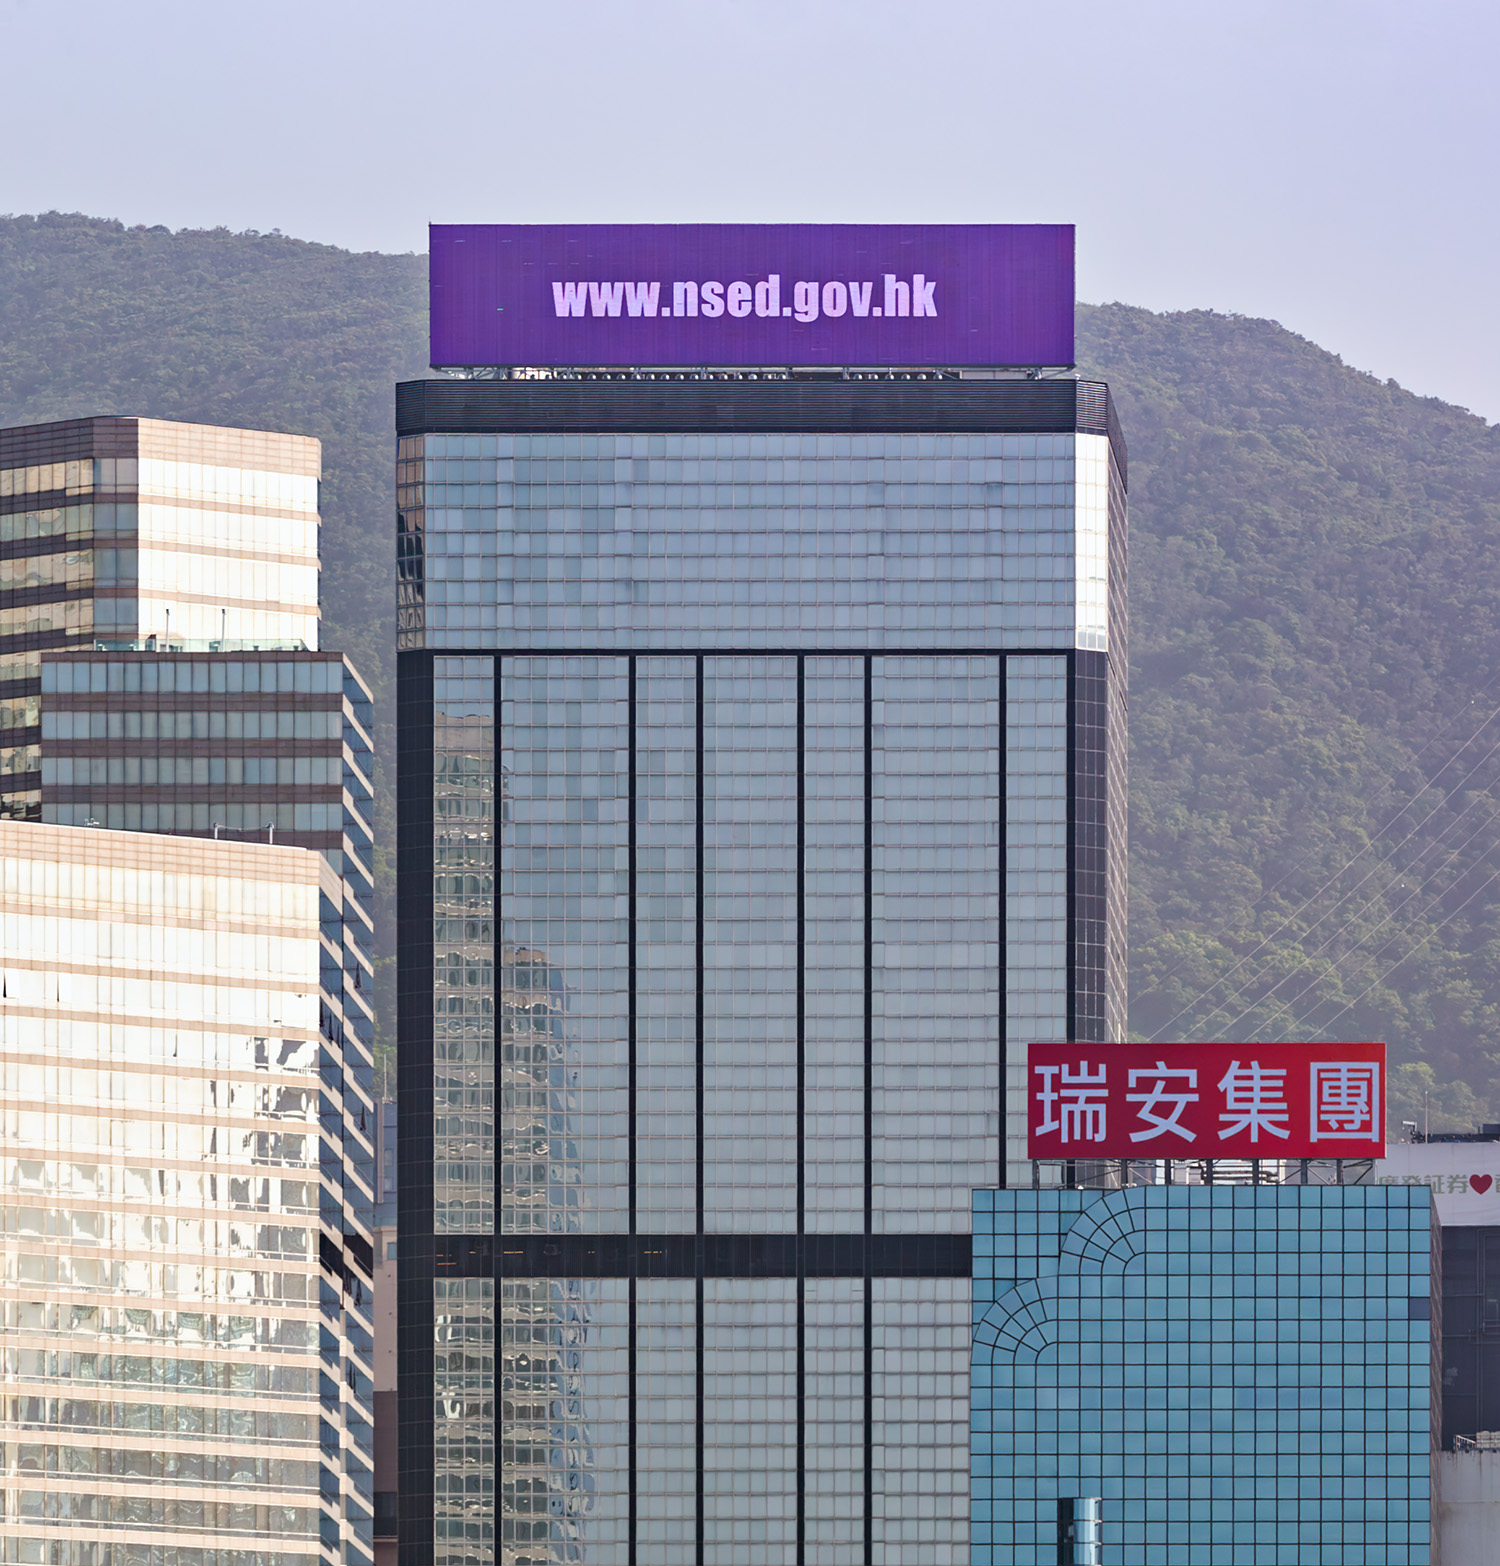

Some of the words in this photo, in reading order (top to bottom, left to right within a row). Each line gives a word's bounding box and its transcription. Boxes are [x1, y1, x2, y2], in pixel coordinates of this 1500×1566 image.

[552, 274, 938, 322] www.nsed.gov.hk
[1034, 1060, 1380, 1144] 瑞安集團
